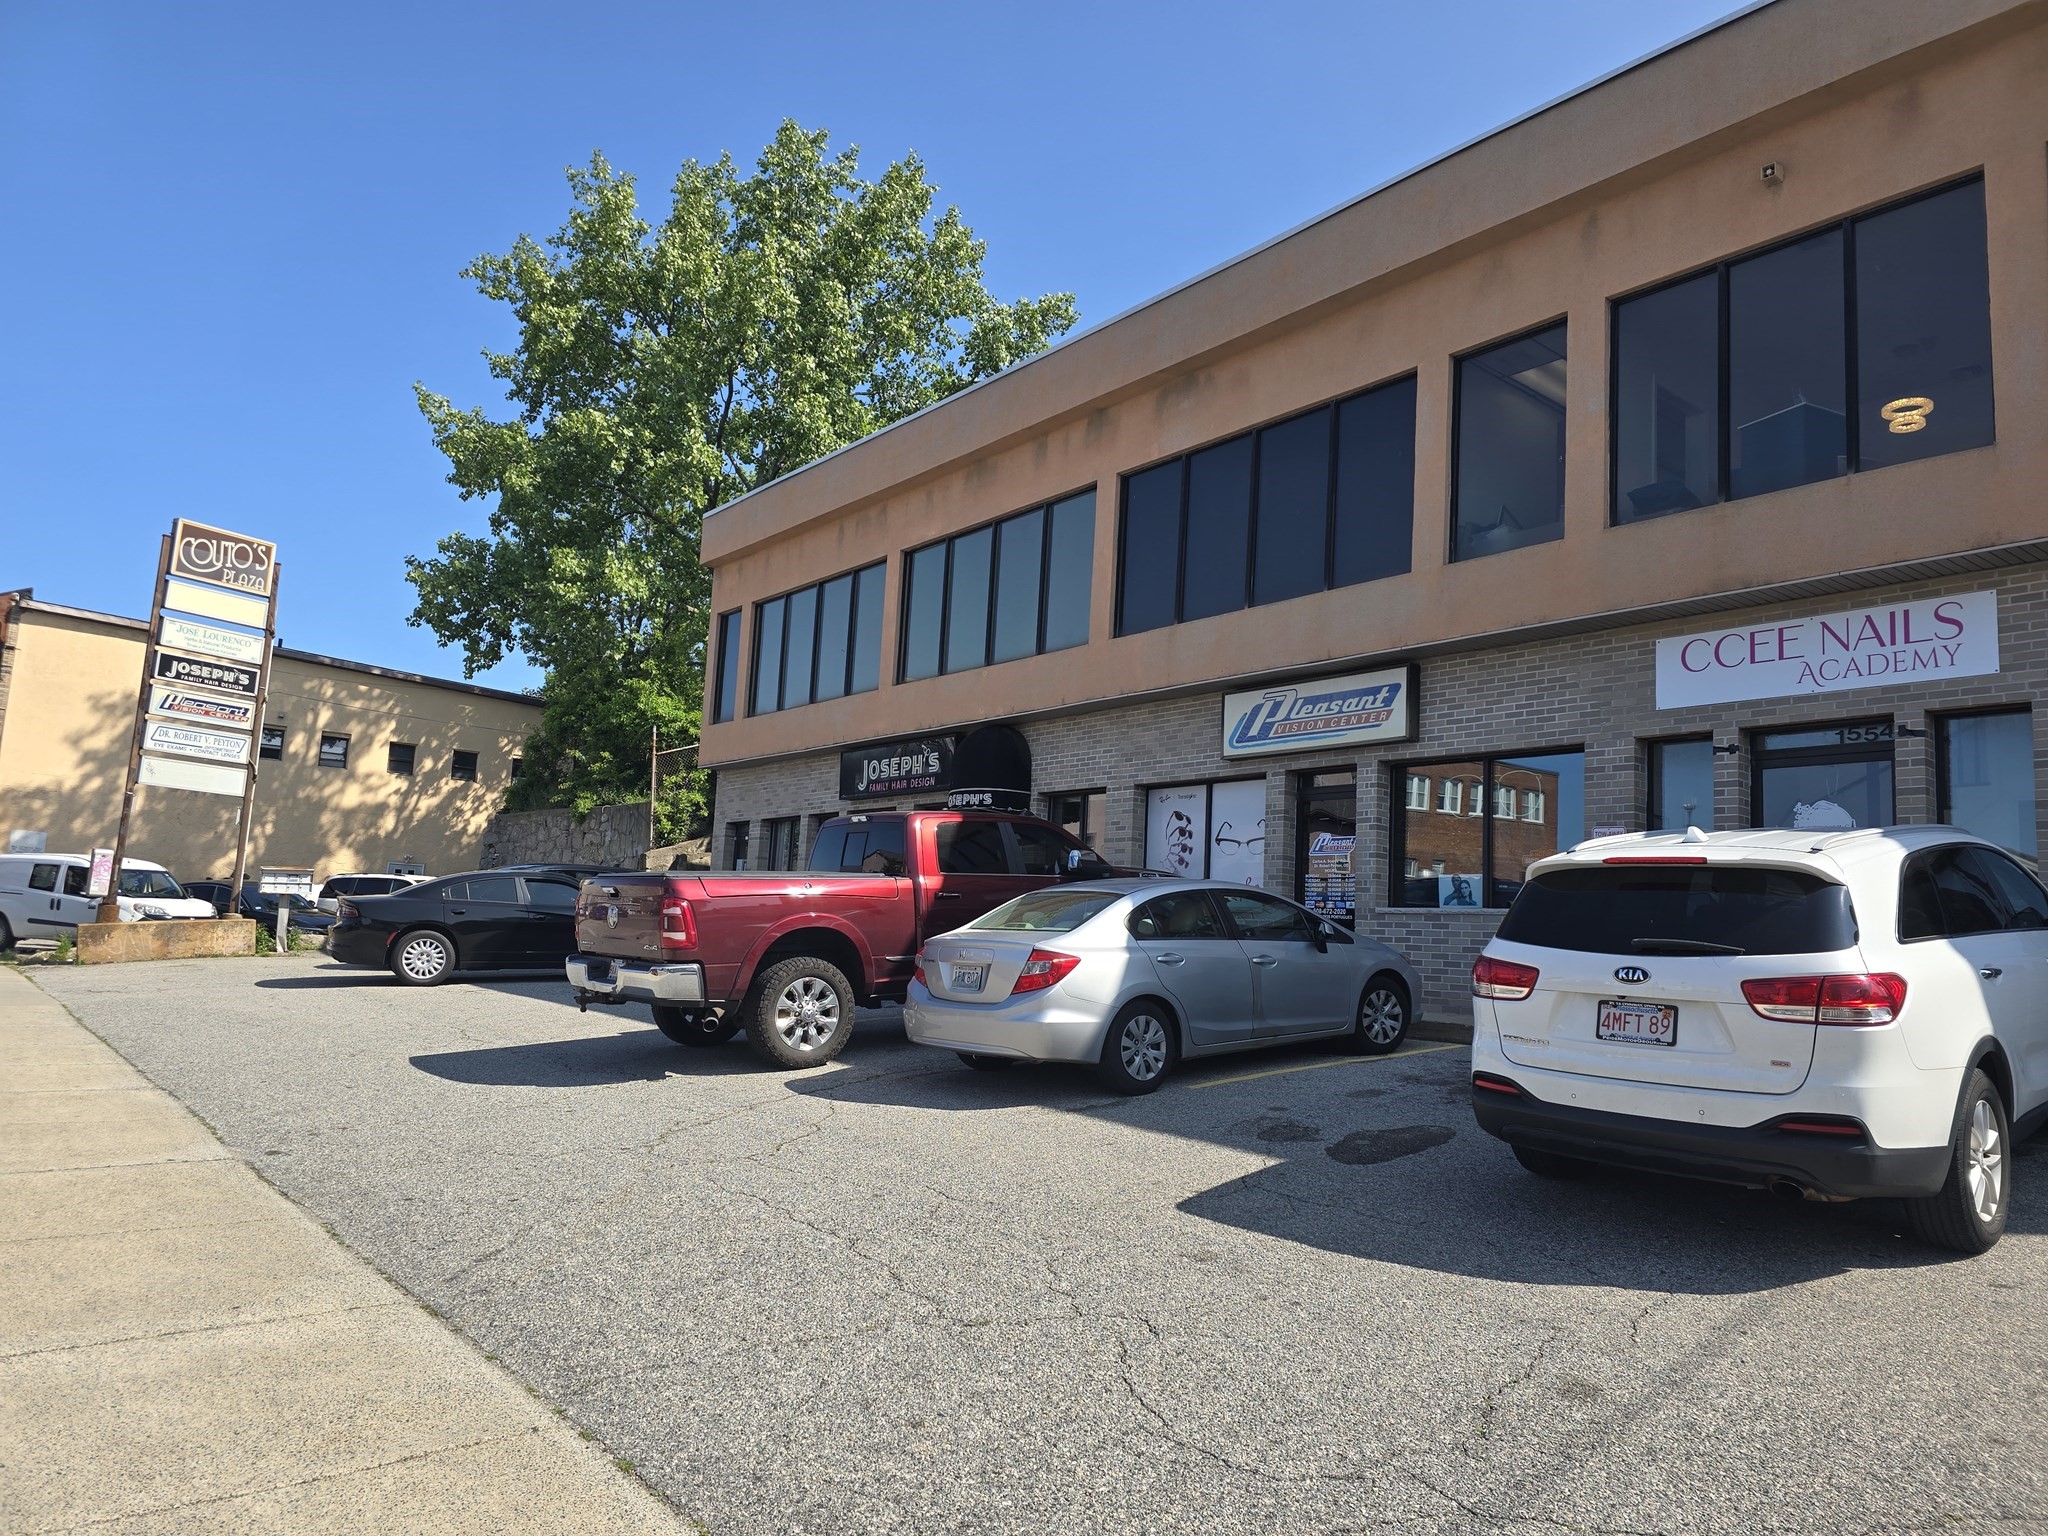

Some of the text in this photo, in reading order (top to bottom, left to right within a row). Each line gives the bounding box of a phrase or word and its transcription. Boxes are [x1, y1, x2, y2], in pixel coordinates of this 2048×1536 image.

[180, 537, 268, 572] COUTO'S
[221, 568, 265, 591] PLAZA
[1680, 601, 1965, 673] CCEE NAILS
[165, 660, 250, 685] JOSEPH'S
[1796, 642, 1963, 687] ACADEMY
[181, 675, 203, 683] FAMILY
[221, 682, 244, 691] DESIGN
[163, 692, 247, 716] Pleasant
[173, 705, 250, 723] VISION CENTER
[1245, 688, 1390, 739] Pleasant
[1277, 711, 1388, 734] VISION CENTER
[1835, 724, 1895, 744] 1554
[158, 729, 242, 749] DR. ROBERT V. PEYTON
[167, 744, 187, 752] EXAMS
[193, 748, 219, 757] CONTACT
[857, 749, 940, 791] JOSEPH'S
[868, 776, 936, 792] FAMILY HAIR DESIGN
[948, 793, 993, 807] OSEPH'S
[1618, 968, 1644, 981] KIA
[1616, 1005, 1659, 1014] Massachusetts
[1601, 1011, 1671, 1036] 4MFT 89
